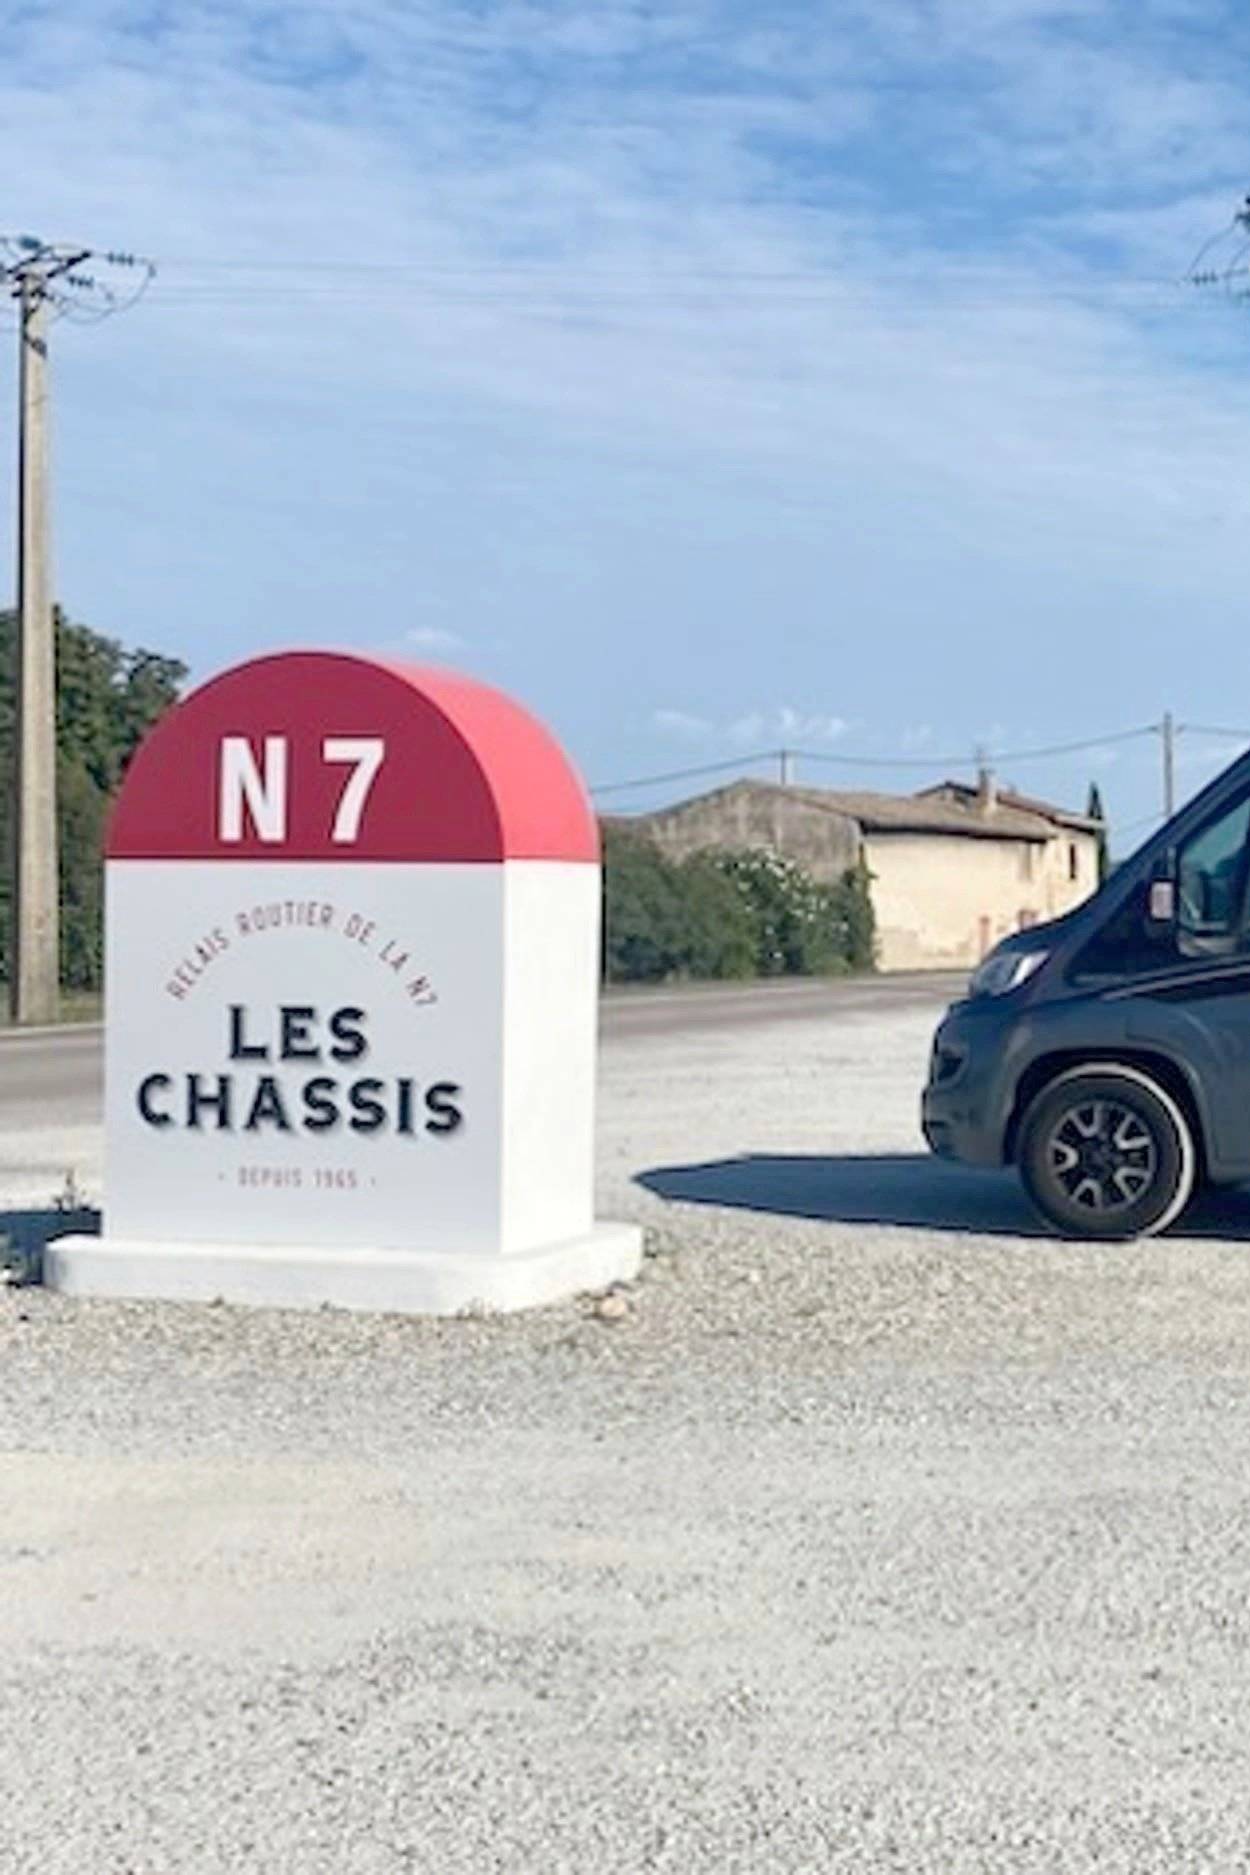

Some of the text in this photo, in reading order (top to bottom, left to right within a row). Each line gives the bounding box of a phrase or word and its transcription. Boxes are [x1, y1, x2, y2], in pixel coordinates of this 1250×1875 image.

[219, 735, 385, 843] N 7
[166, 901, 438, 1006] RELAIS ROUTIER DE LA N7
[229, 1004, 370, 1062] LES
[137, 1072, 464, 1135] CHASSIS
[238, 1166, 358, 1189] DEPUIS 1965
